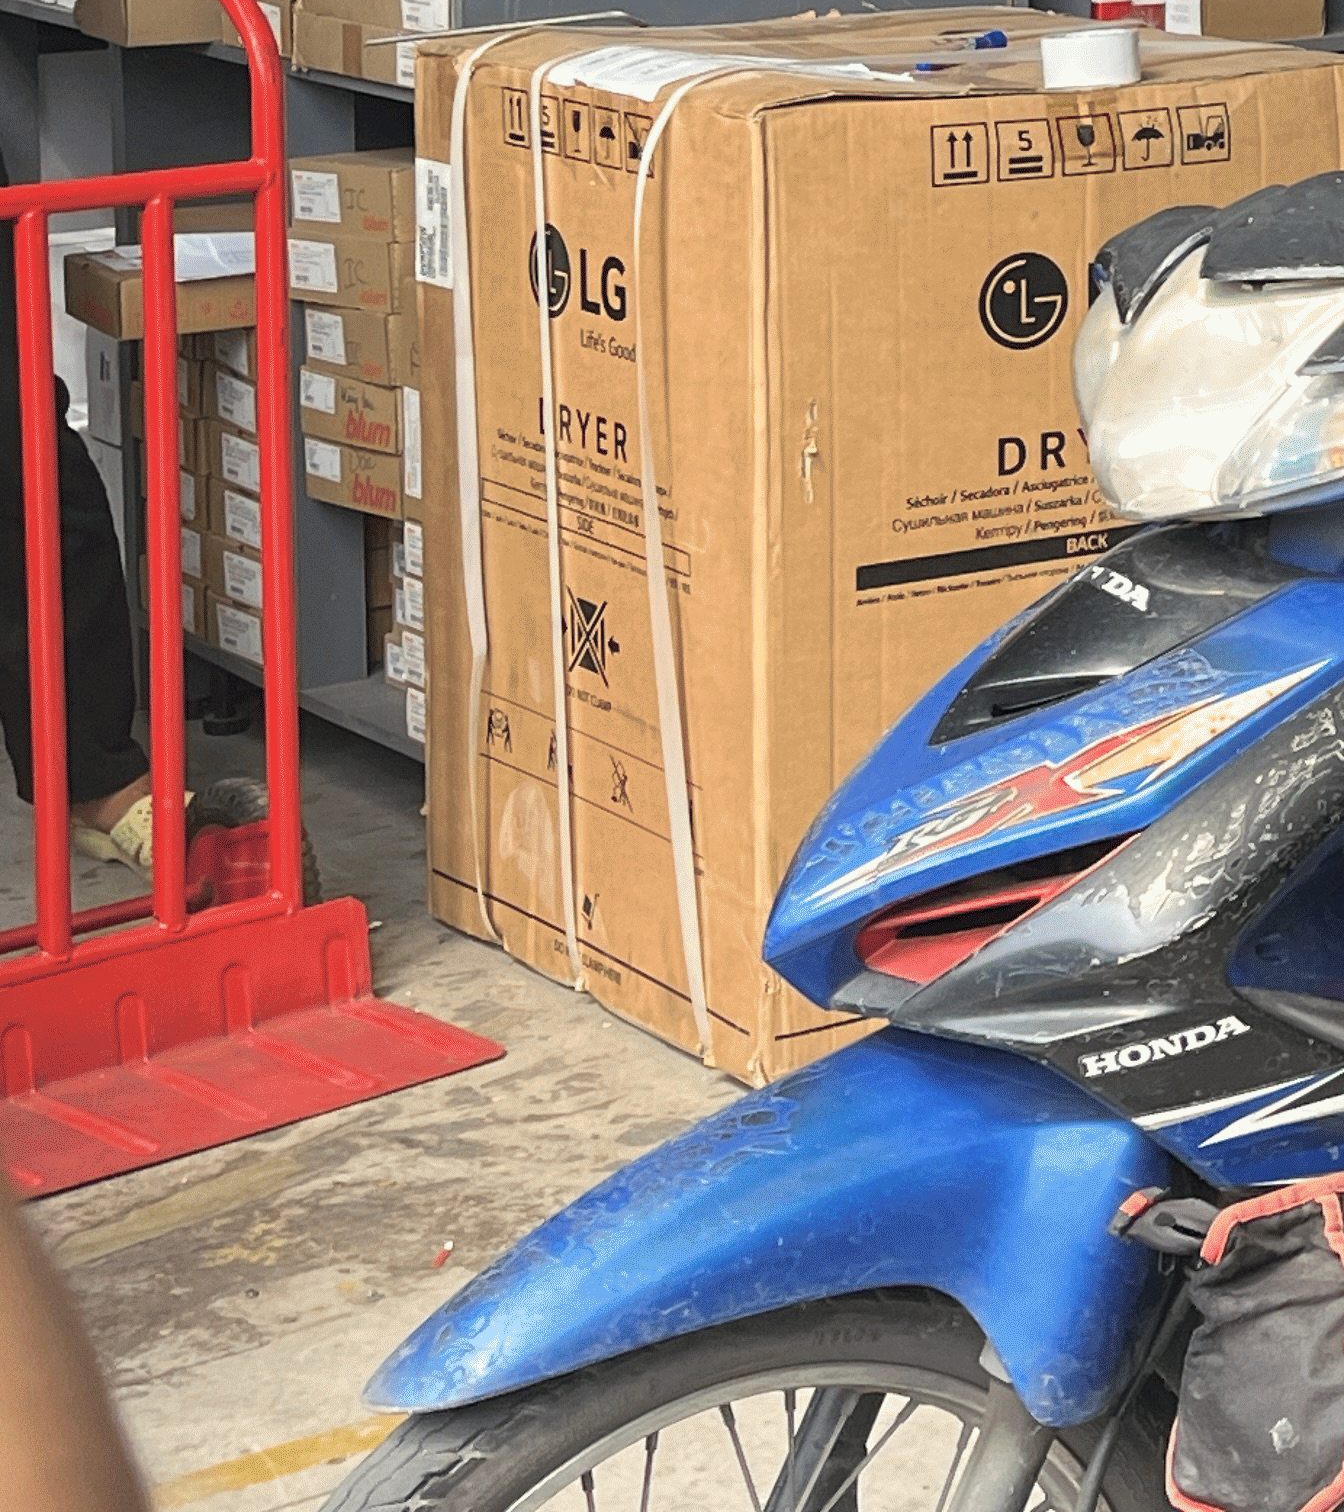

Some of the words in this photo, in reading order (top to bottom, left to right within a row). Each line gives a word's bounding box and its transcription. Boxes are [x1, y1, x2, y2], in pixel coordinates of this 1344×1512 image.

[579, 248, 627, 322] LG
[579, 328, 607, 354] Life's
[607, 336, 637, 364] Good
[346, 408, 391, 448] blum
[352, 473, 397, 513] blum
[905, 494, 949, 510] Séchoir
[959, 485, 1010, 503] Secadora
[1021, 474, 1089, 494] Asciugatrice
[1033, 495, 1083, 512] Suszarka
[970, 504, 1024, 521] машина
[1033, 513, 1088, 533] Pengering
[1065, 533, 1109, 555] BACK
[1080, 1014, 1253, 1079] HONDA
